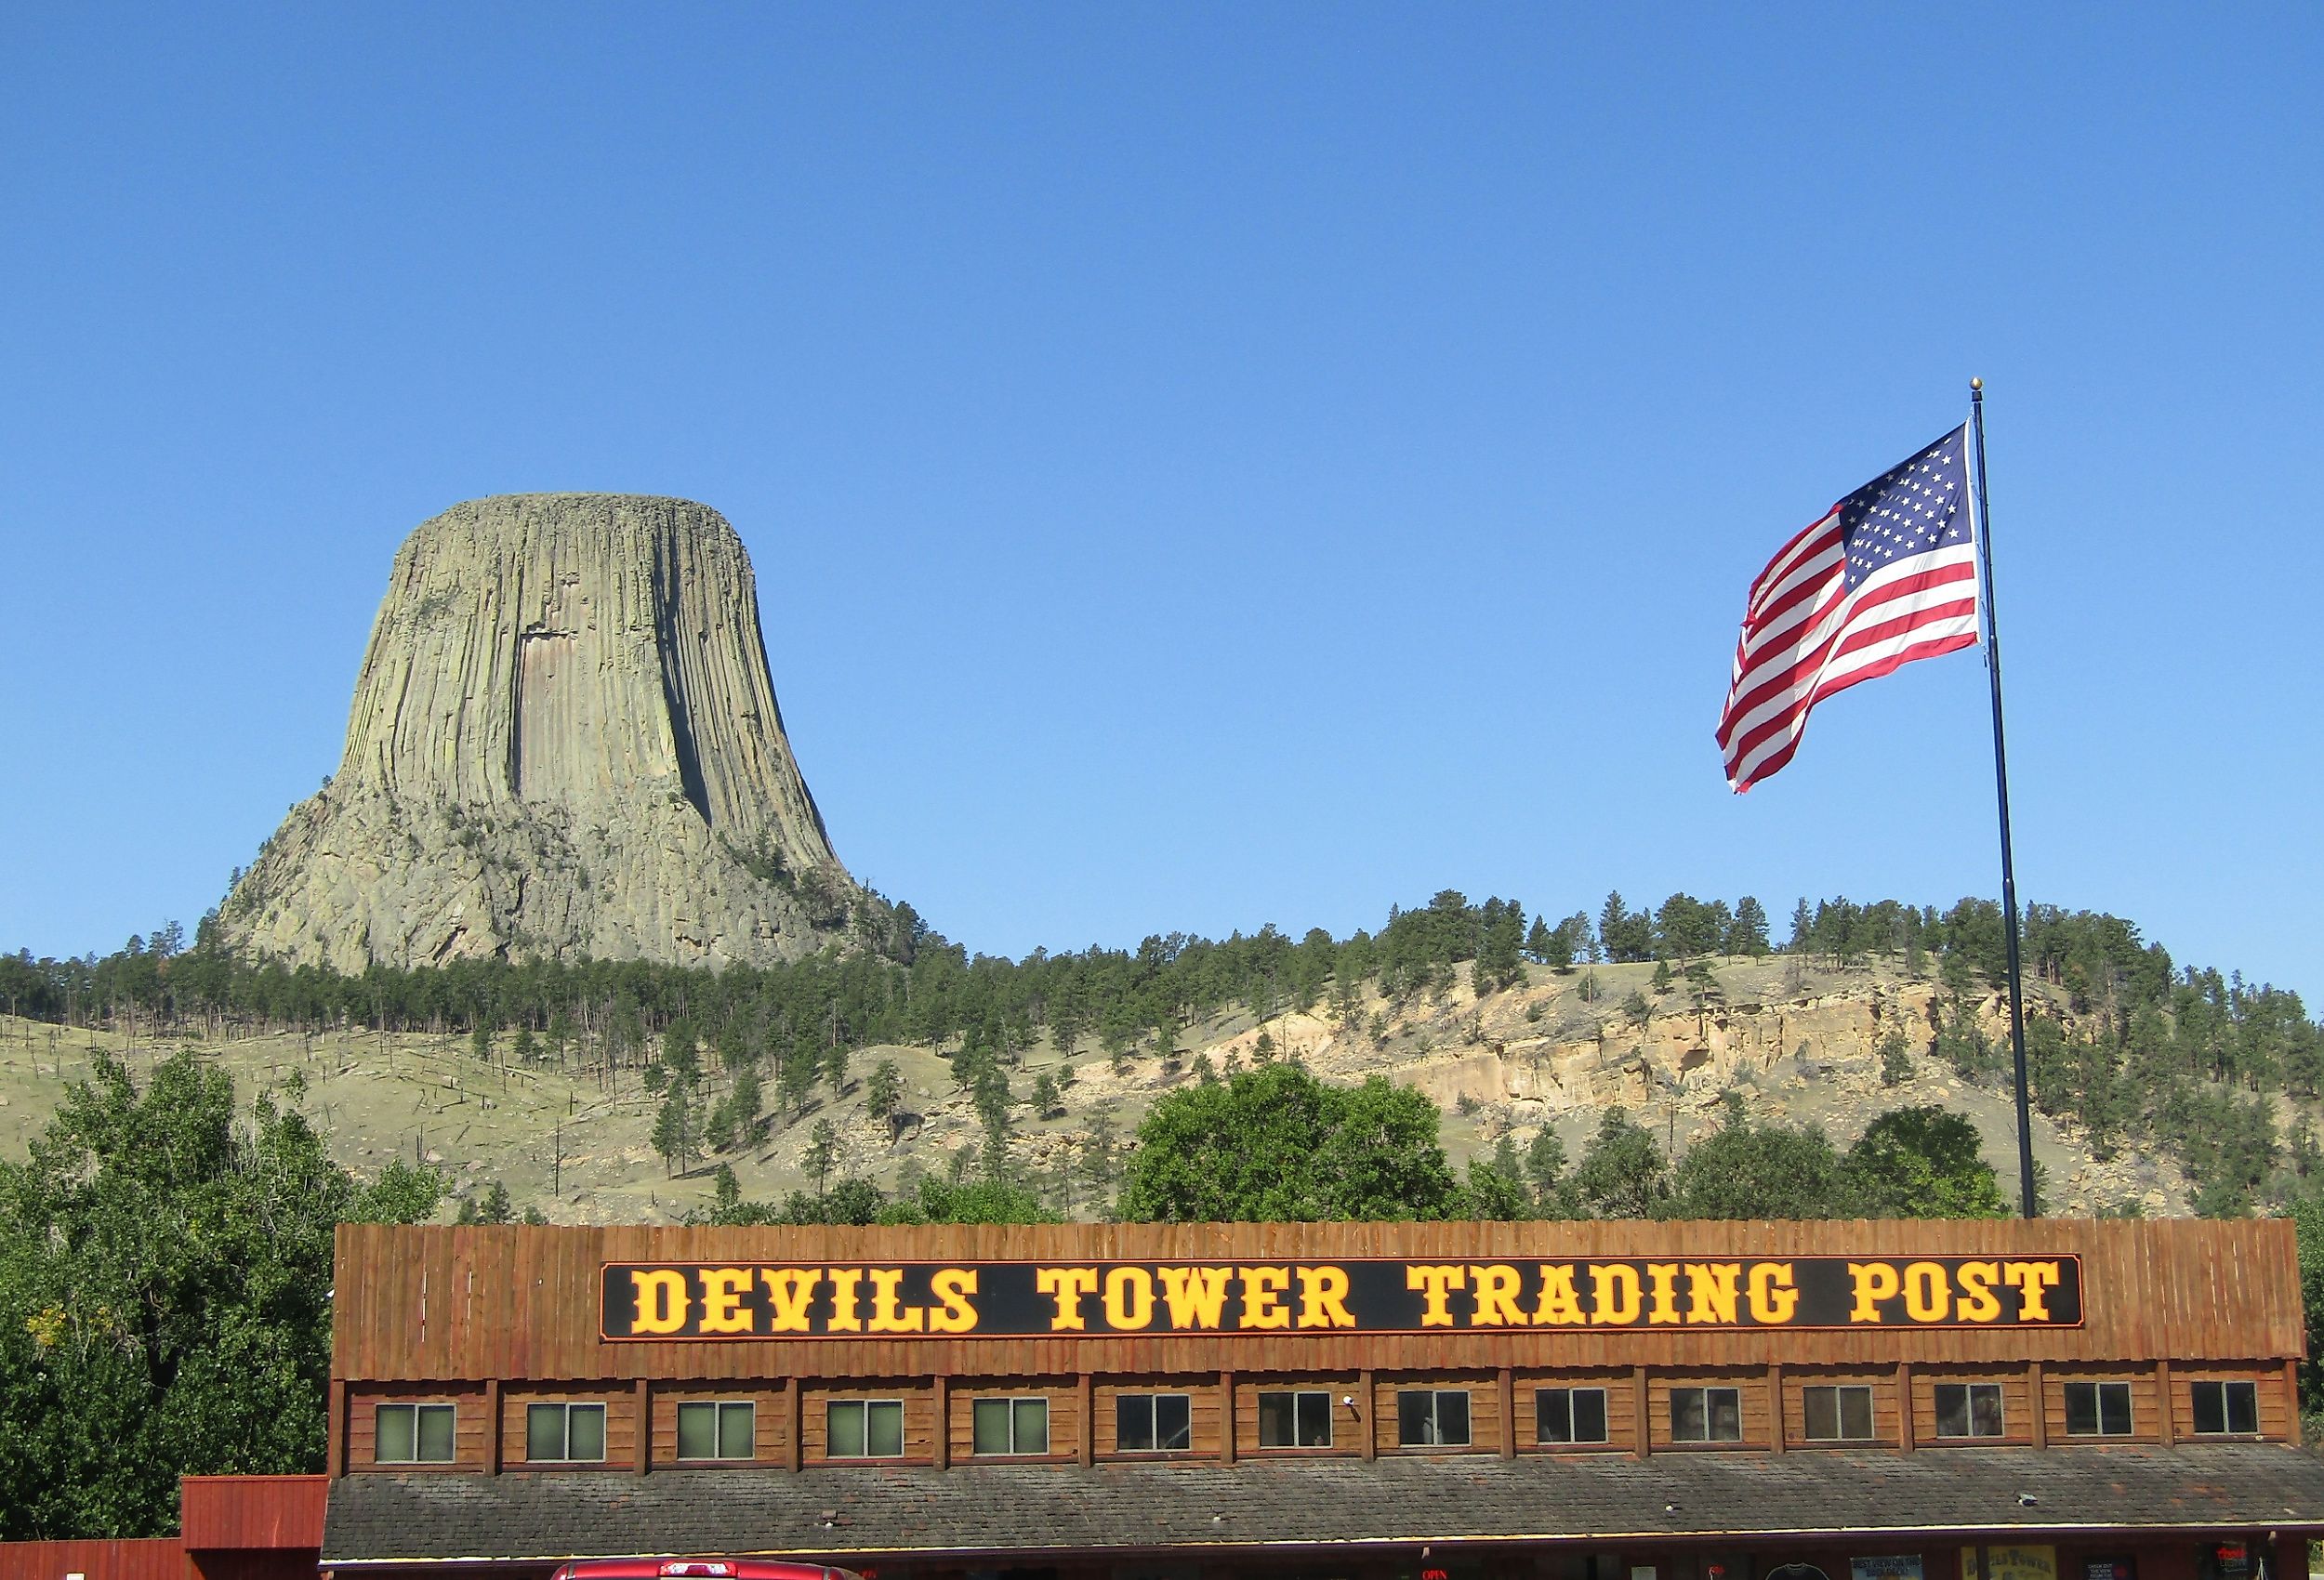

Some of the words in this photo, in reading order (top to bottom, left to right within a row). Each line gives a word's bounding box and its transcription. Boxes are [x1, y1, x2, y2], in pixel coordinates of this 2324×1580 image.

[630, 1267, 979, 1335] DEVILS
[1036, 1265, 1357, 1332] TOWER
[1406, 1261, 1800, 1328] TRADING
[1846, 1260, 2060, 1323] POST
[1421, 1569, 1447, 1580] OPEN
